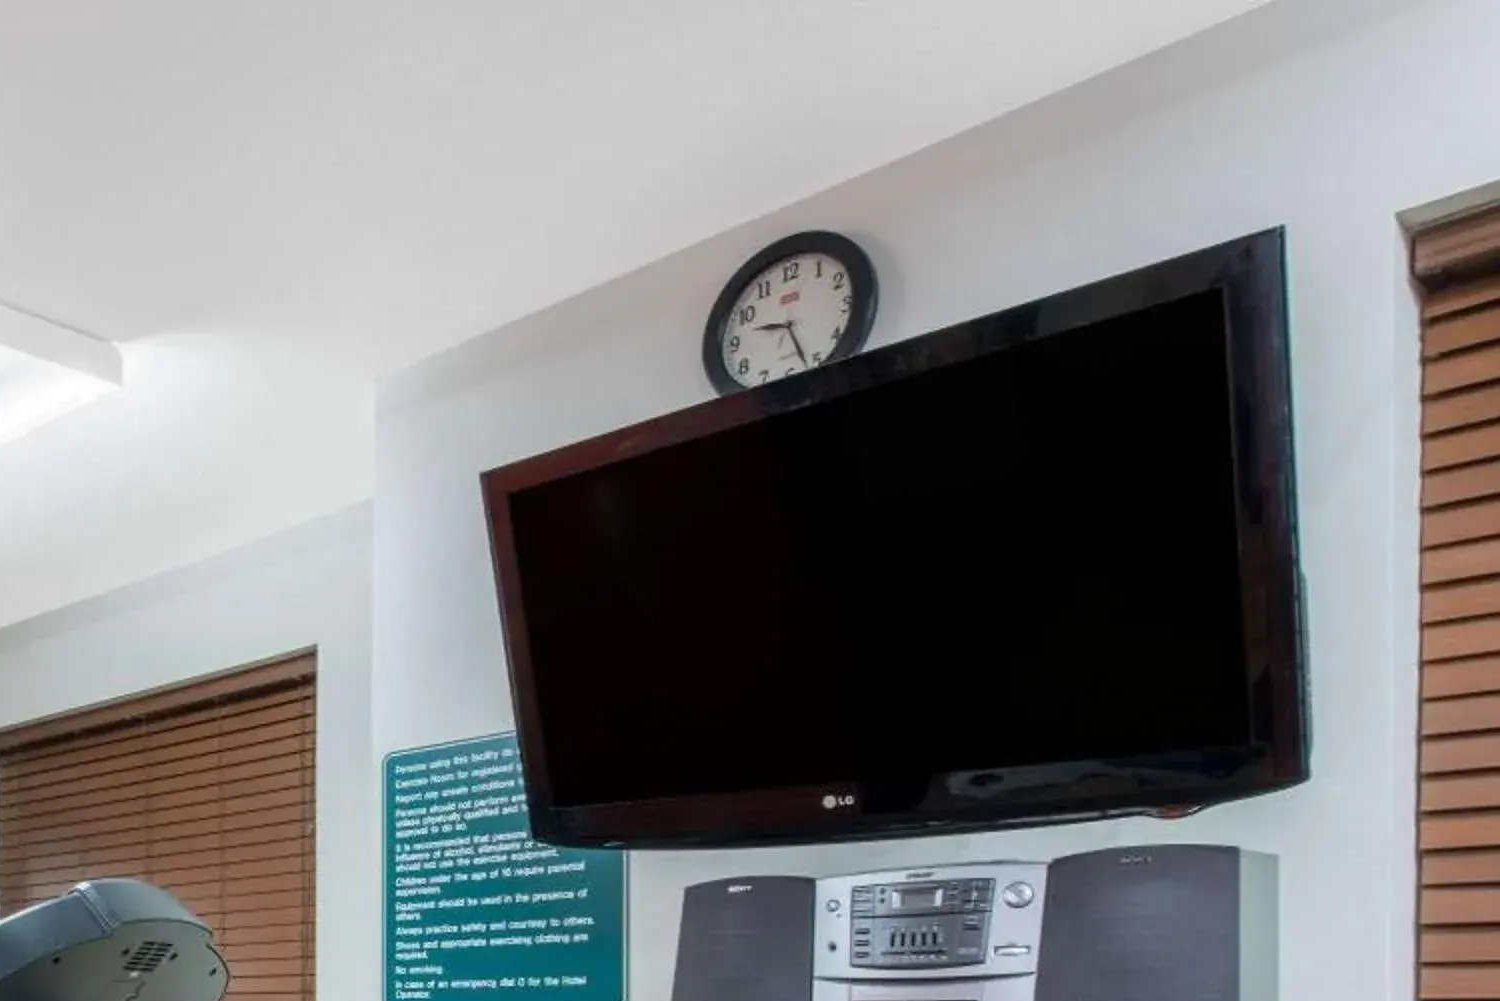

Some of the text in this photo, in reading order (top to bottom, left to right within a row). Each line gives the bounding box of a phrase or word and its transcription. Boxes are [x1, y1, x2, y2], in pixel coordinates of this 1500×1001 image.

[782, 261, 799, 283] 12
[815, 260, 823, 278] 1
[832, 271, 845, 290] 2
[757, 281, 772, 299] 11
[841, 295, 852, 313] 3
[739, 305, 756, 325] 10
[831, 326, 842, 341] 4
[729, 335, 741, 352] 9
[738, 357, 750, 375] 8
[757, 369, 770, 383] 7
